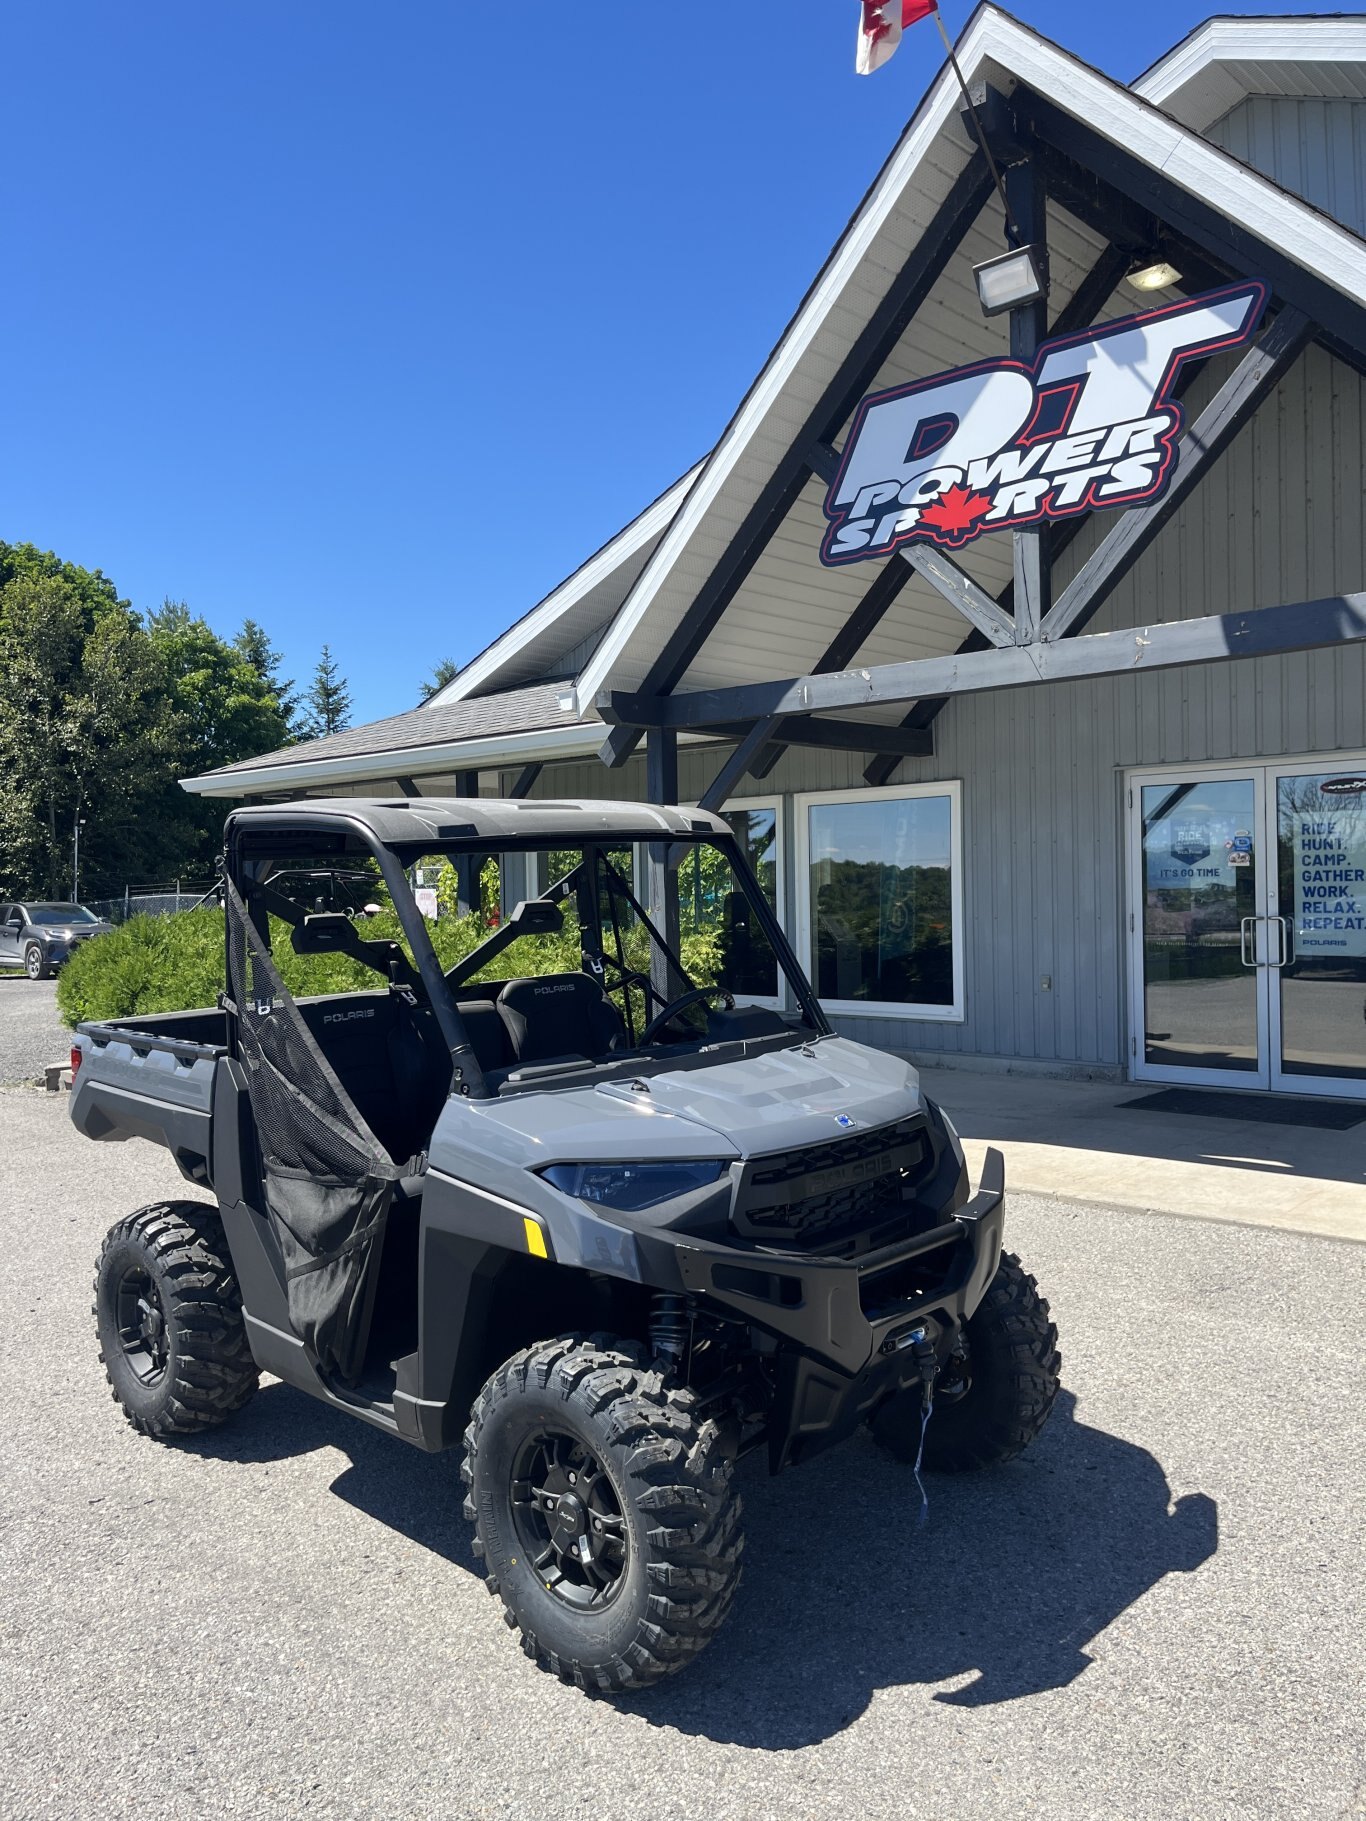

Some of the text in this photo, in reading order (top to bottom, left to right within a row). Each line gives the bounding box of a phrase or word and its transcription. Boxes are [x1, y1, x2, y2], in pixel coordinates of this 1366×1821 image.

[834, 294, 1255, 506] DT
[848, 415, 1171, 520] POWER
[830, 452, 1161, 555] SPRTS
[1301, 838, 1348, 851] HUNT.
[1301, 854, 1351, 867] CAMP.
[1160, 868, 1220, 878] IT'S GO TIME
[1302, 885, 1354, 898] WORK.
[1302, 901, 1361, 914] RELAX.
[534, 983, 575, 995] POLARIS
[323, 1009, 375, 1024] POLARIS
